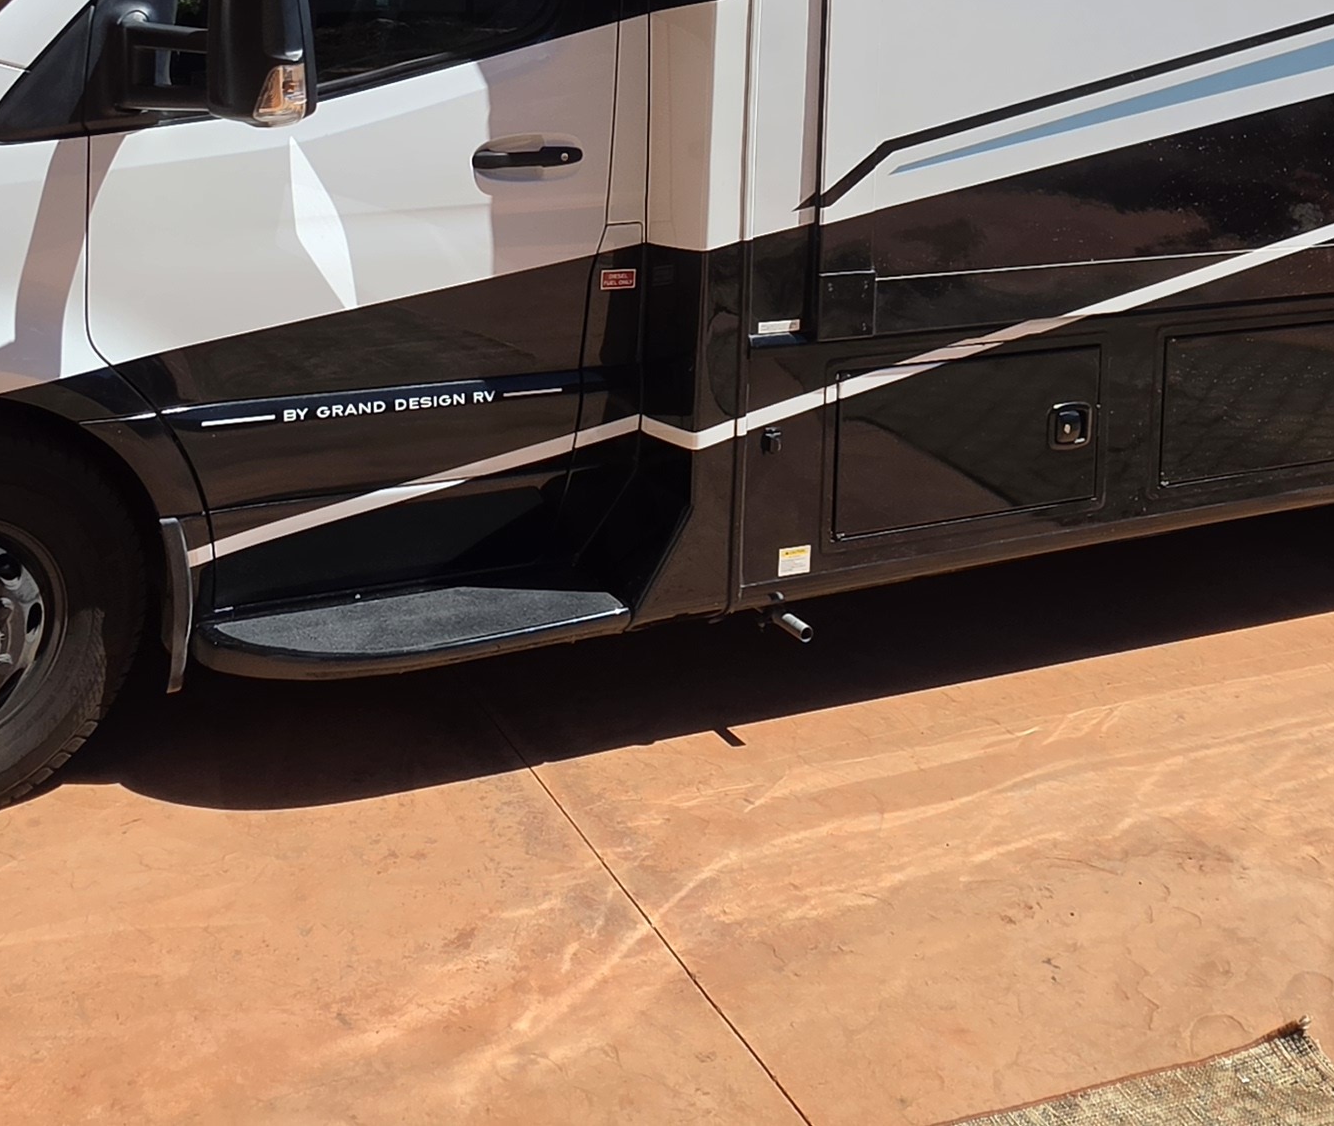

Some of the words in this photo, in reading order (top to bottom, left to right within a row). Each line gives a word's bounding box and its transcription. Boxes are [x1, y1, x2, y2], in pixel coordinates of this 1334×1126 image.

[283, 407, 309, 423] BY
[316, 400, 387, 419] GRAND
[394, 392, 466, 412] DESIGN
[473, 390, 496, 404] RV
